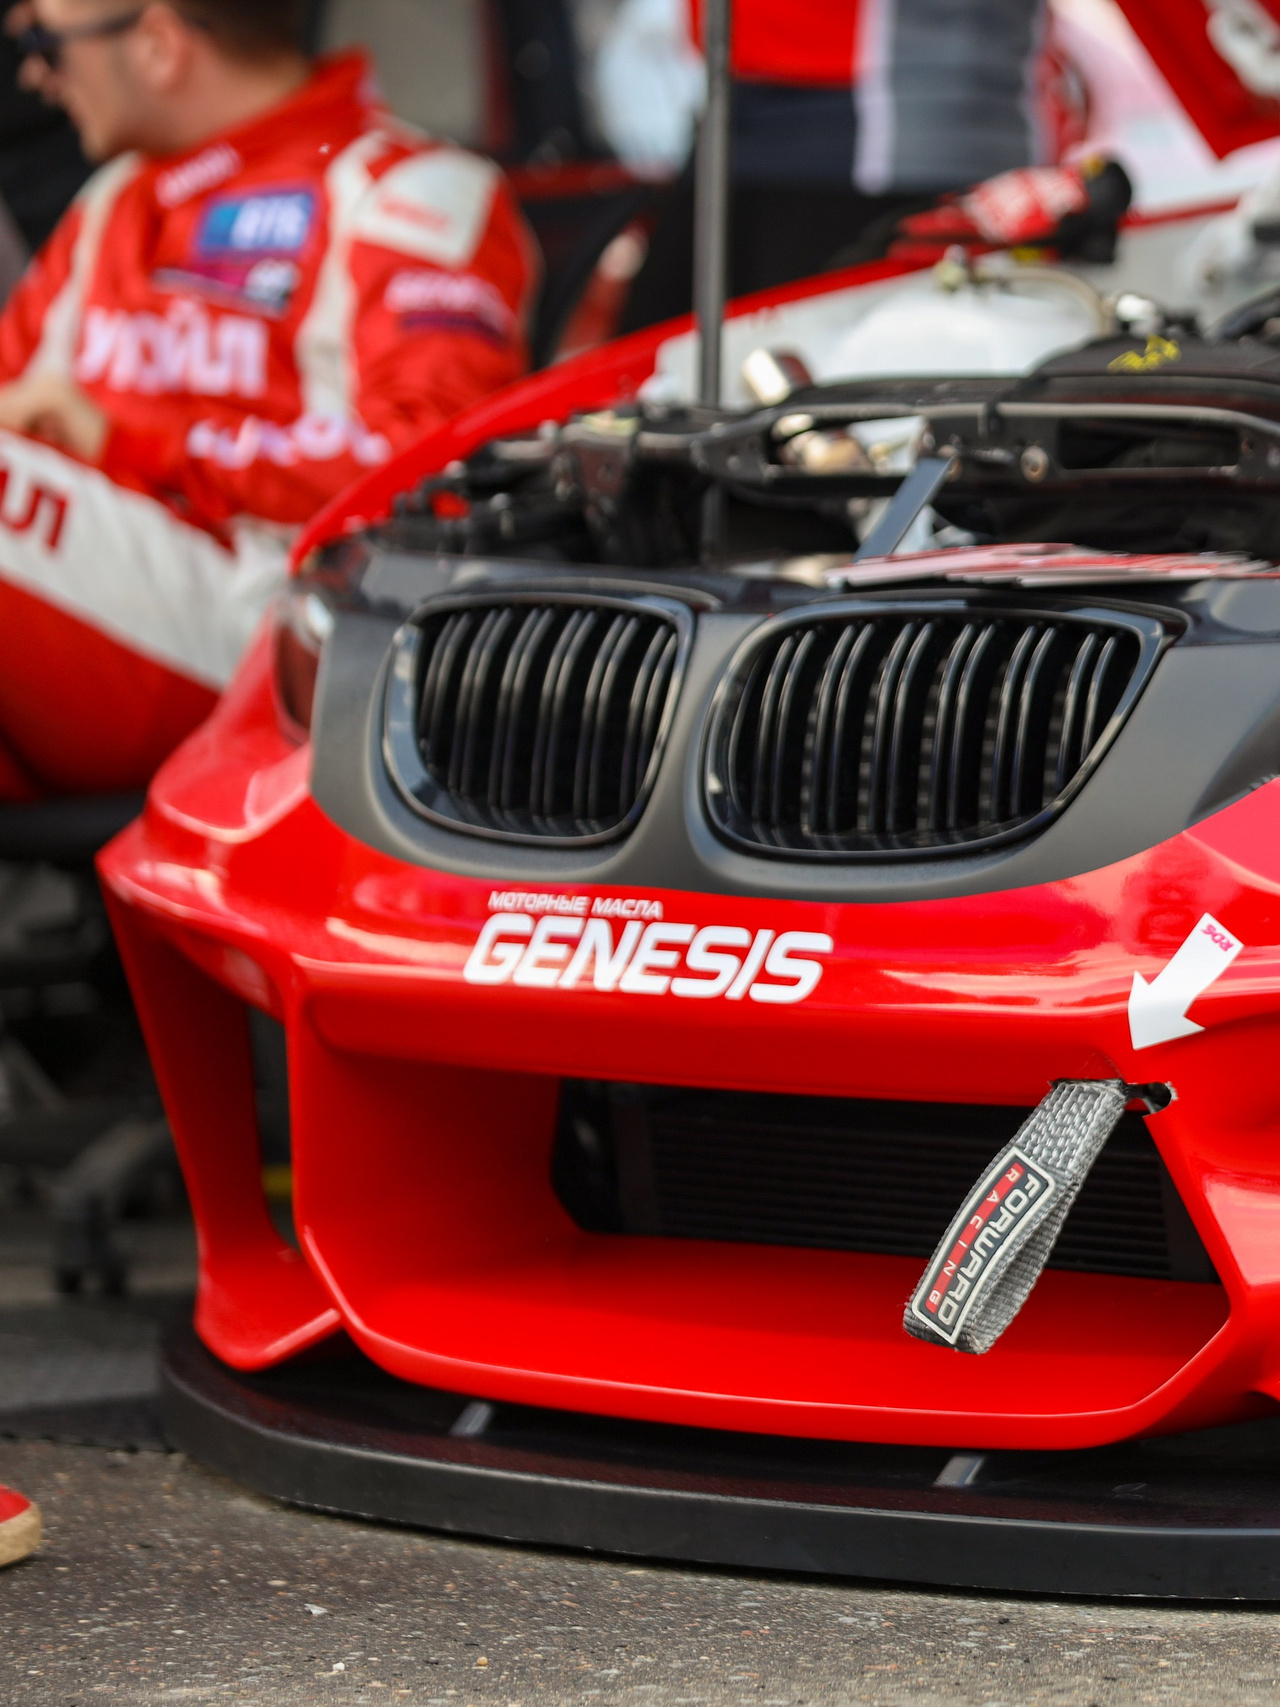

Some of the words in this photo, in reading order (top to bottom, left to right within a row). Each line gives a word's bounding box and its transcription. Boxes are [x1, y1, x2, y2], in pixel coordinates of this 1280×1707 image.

[488, 890, 590, 916] МОТОРНЫЕ
[591, 897, 664, 920] МАСЛА
[1200, 923, 1235, 952] RDS
[463, 912, 834, 1005] GENESIS
[928, 1167, 1021, 1305] RACING
[937, 1171, 1042, 1326] FORWARD
